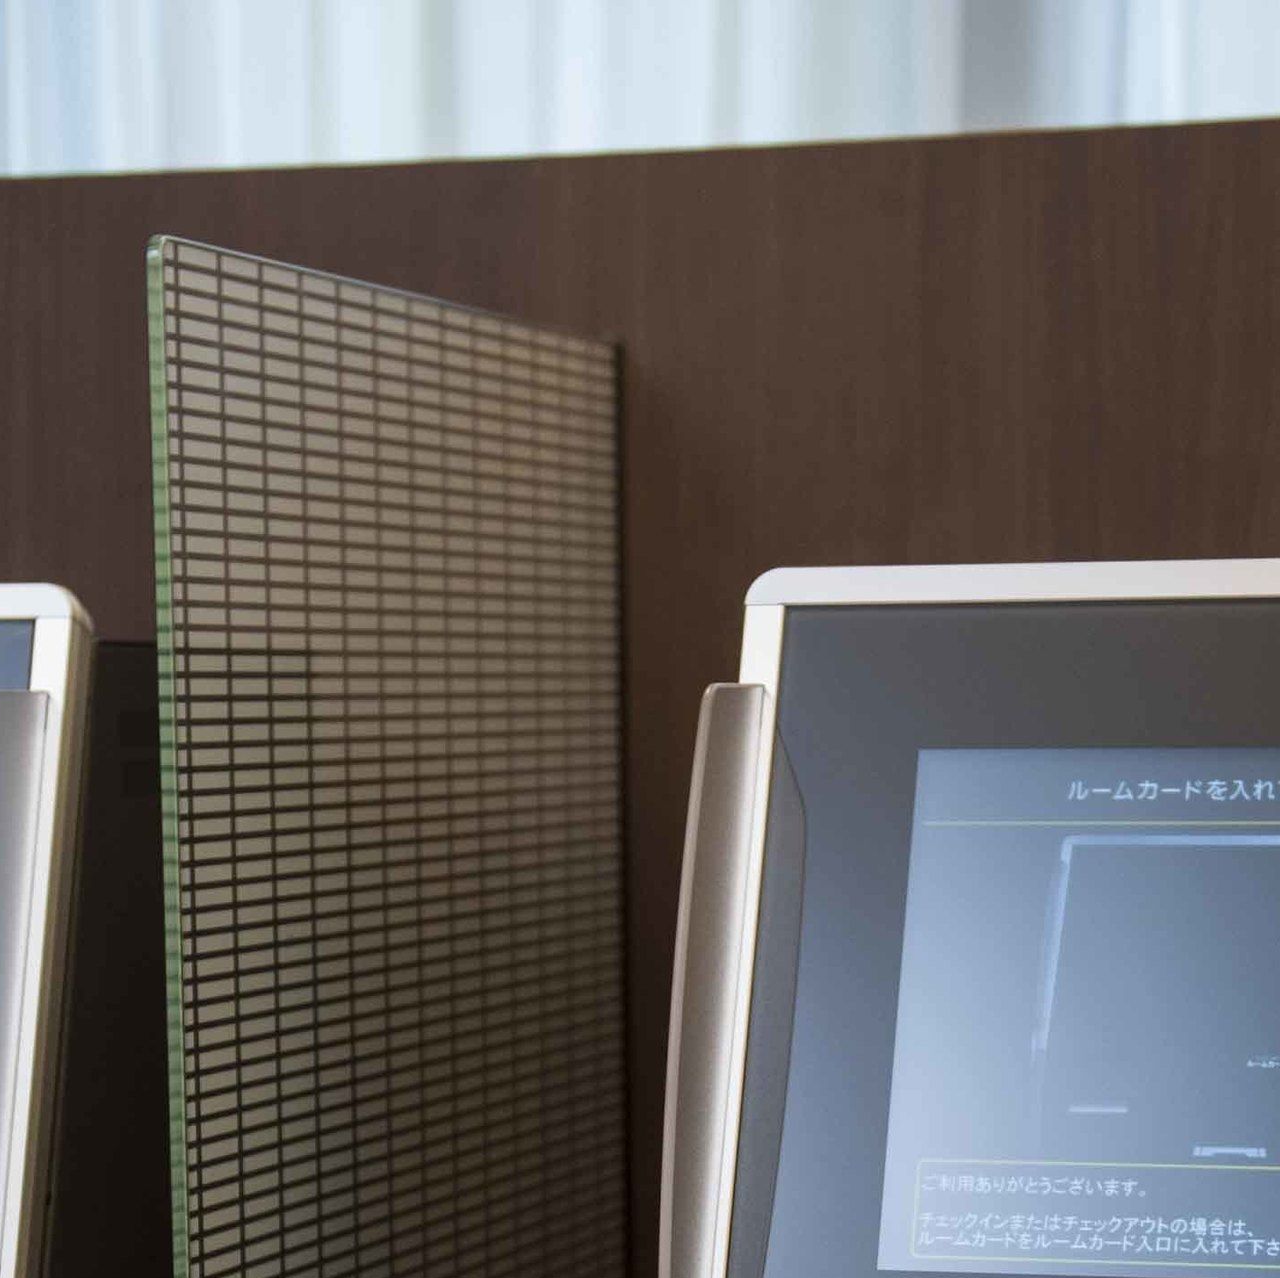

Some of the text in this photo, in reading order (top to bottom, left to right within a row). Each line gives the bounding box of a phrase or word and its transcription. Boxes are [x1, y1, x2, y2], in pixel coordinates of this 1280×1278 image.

[921, 1174, 1147, 1197] ご利用ありがとうございます。
[919, 1212, 1254, 1237] チェックインまたはチェックアウトの場合は、
